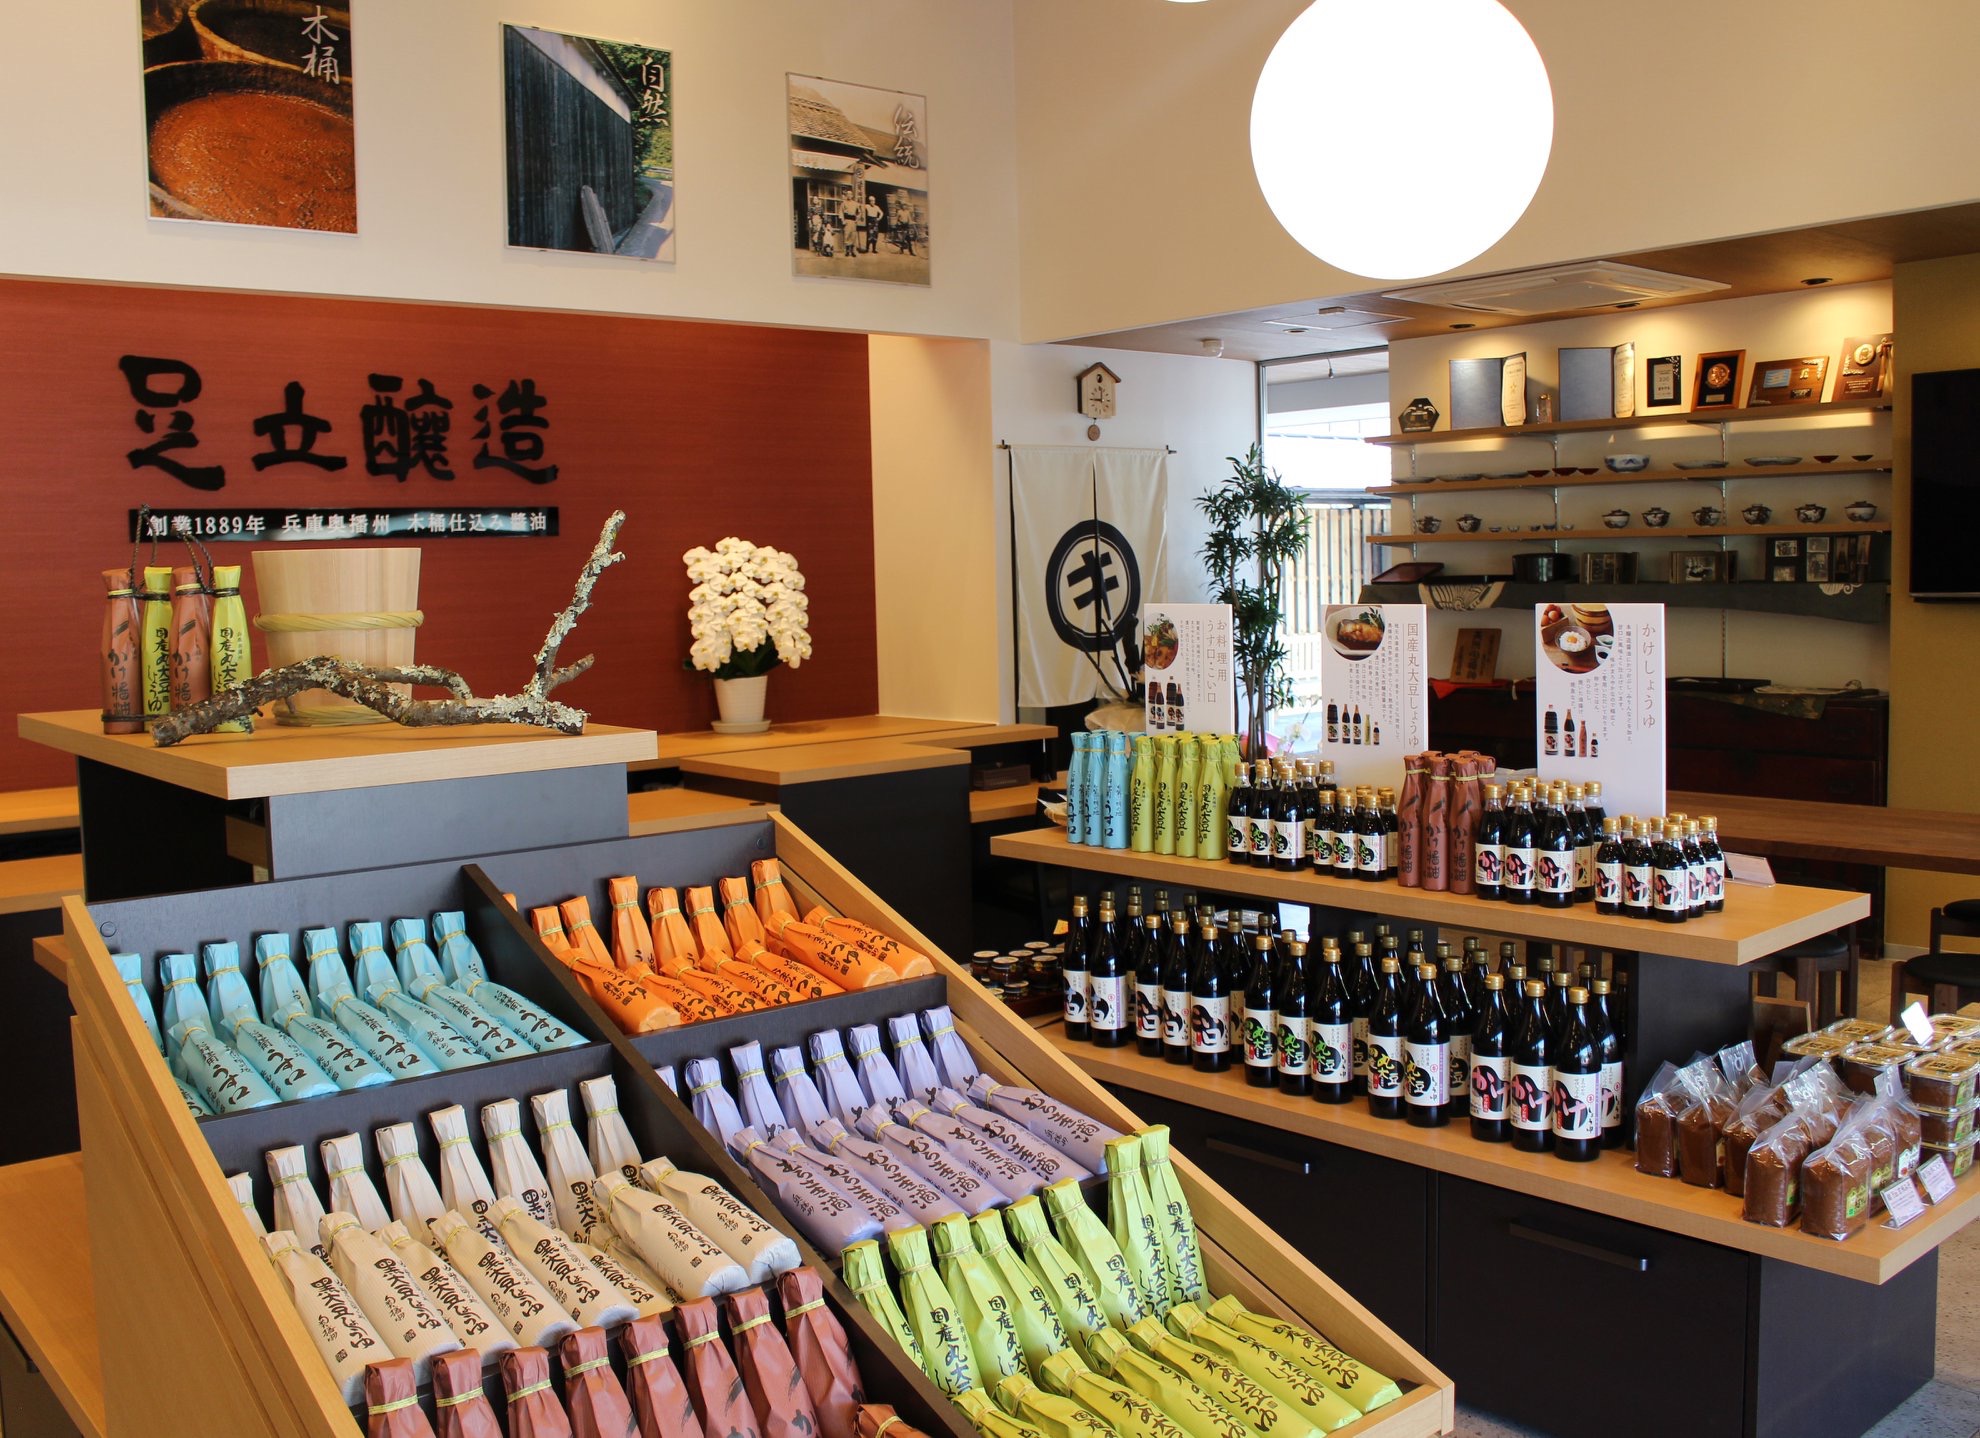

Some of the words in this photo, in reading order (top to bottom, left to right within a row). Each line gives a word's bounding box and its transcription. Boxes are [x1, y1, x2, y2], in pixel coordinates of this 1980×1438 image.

[301, 5, 340, 85] 木桶
[640, 56, 669, 128] 自然
[893, 104, 921, 170] 伝統
[1216, 620, 1228, 682] お料理用
[1407, 623, 1420, 748] 国産丸大豆しょうゆ
[1643, 623, 1656, 729] かけしょうゆ
[1512, 1074, 1553, 1123] かけ
